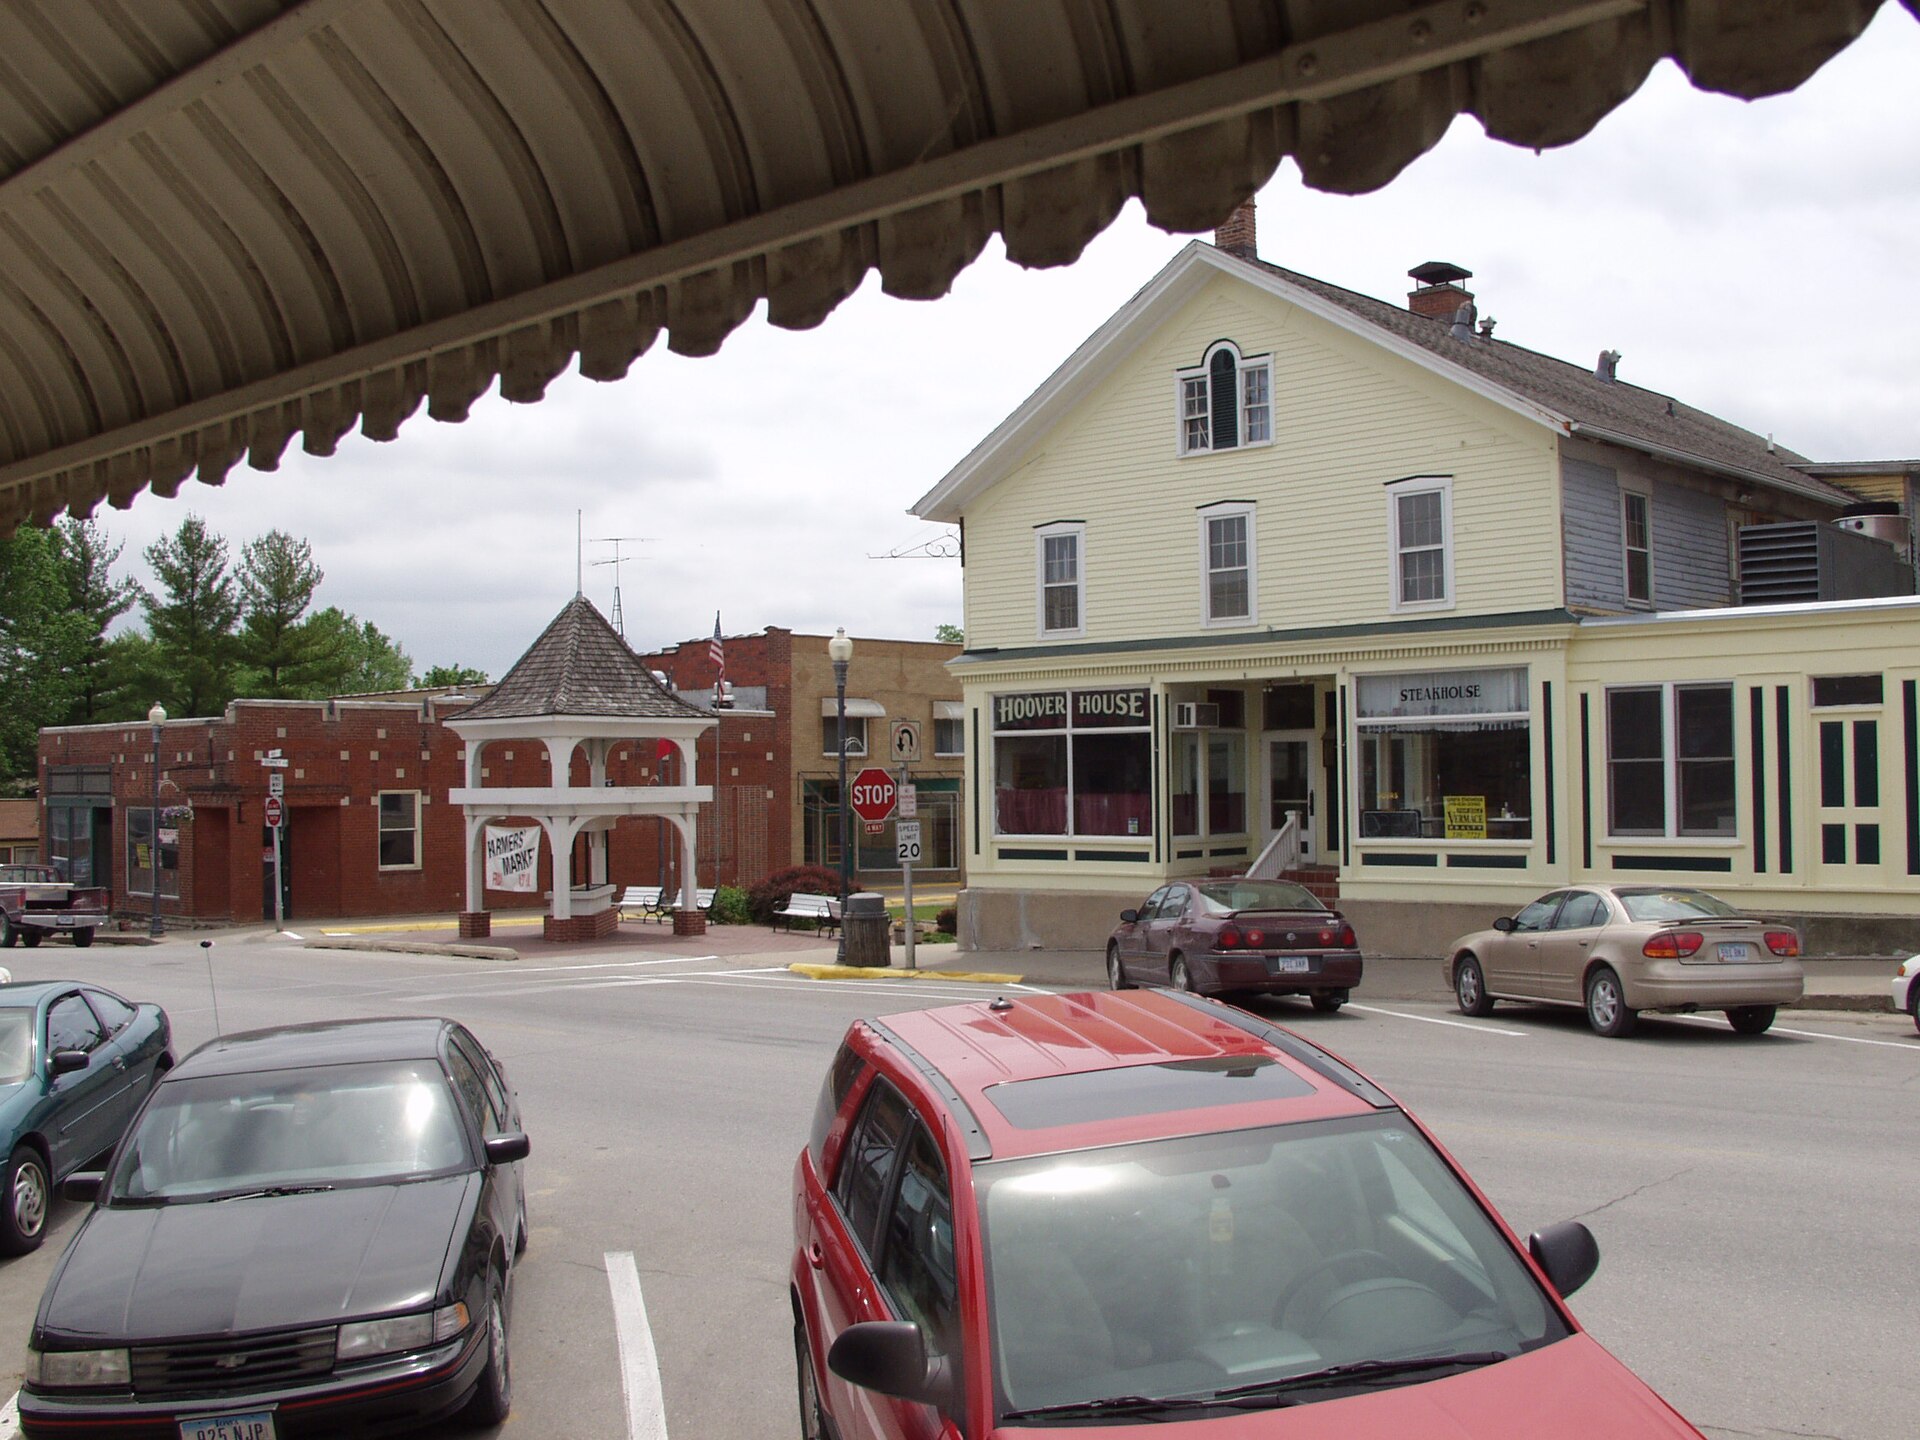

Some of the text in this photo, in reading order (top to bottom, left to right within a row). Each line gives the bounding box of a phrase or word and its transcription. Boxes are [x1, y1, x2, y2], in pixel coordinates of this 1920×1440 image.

[1400, 685, 1482, 702] STEAKHOUSE
[999, 692, 1145, 723] HOOVER HOUSE
[853, 784, 894, 805] STOP
[899, 843, 920, 858] 20
